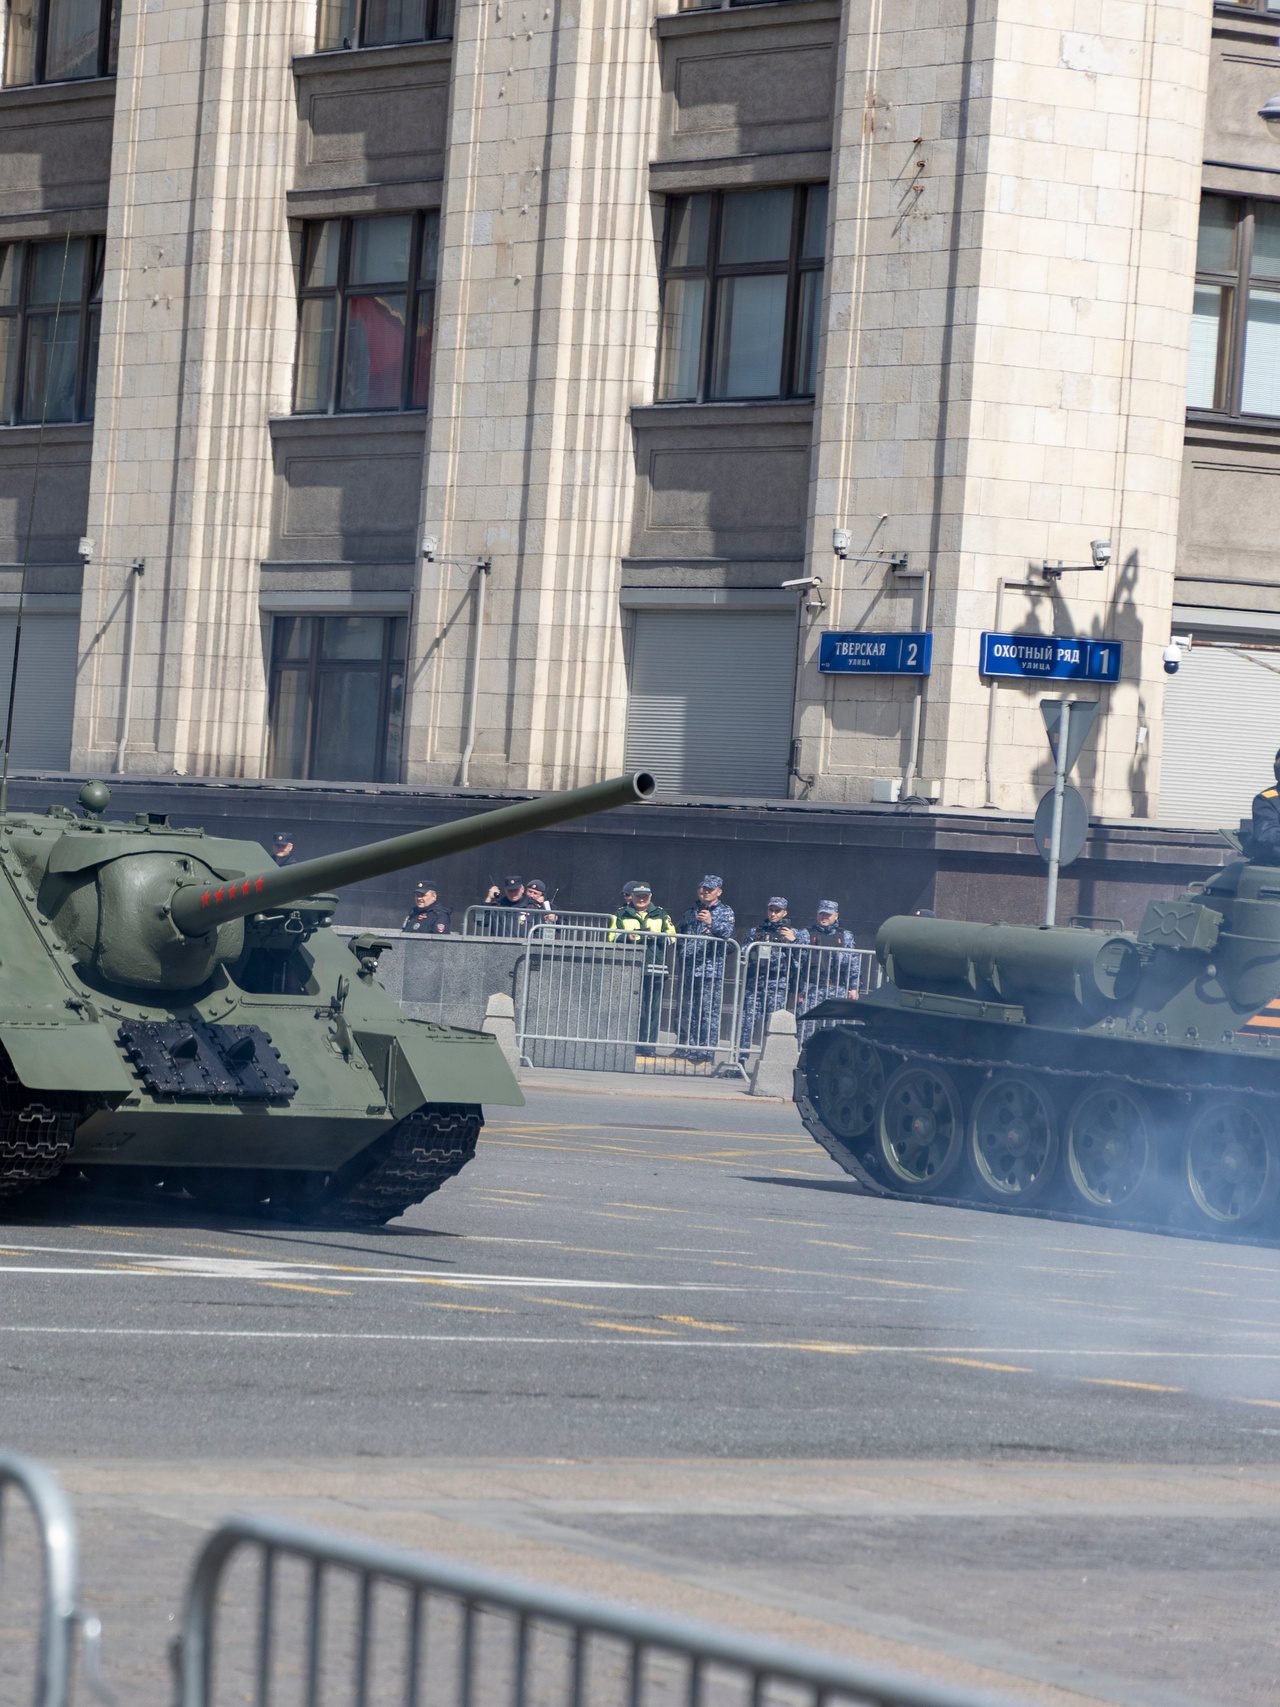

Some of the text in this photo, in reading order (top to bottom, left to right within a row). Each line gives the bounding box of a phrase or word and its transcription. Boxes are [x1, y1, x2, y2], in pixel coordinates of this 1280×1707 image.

[835, 642, 887, 656] ТВЕРСКАЯ
[906, 643, 918, 666] 2
[994, 644, 1080, 664] ОХОТНЫЙ РЯД
[848, 658, 871, 666] УЛИЦА
[1021, 661, 1051, 671] УЛИЦА
[1099, 648, 1110, 674] 1
